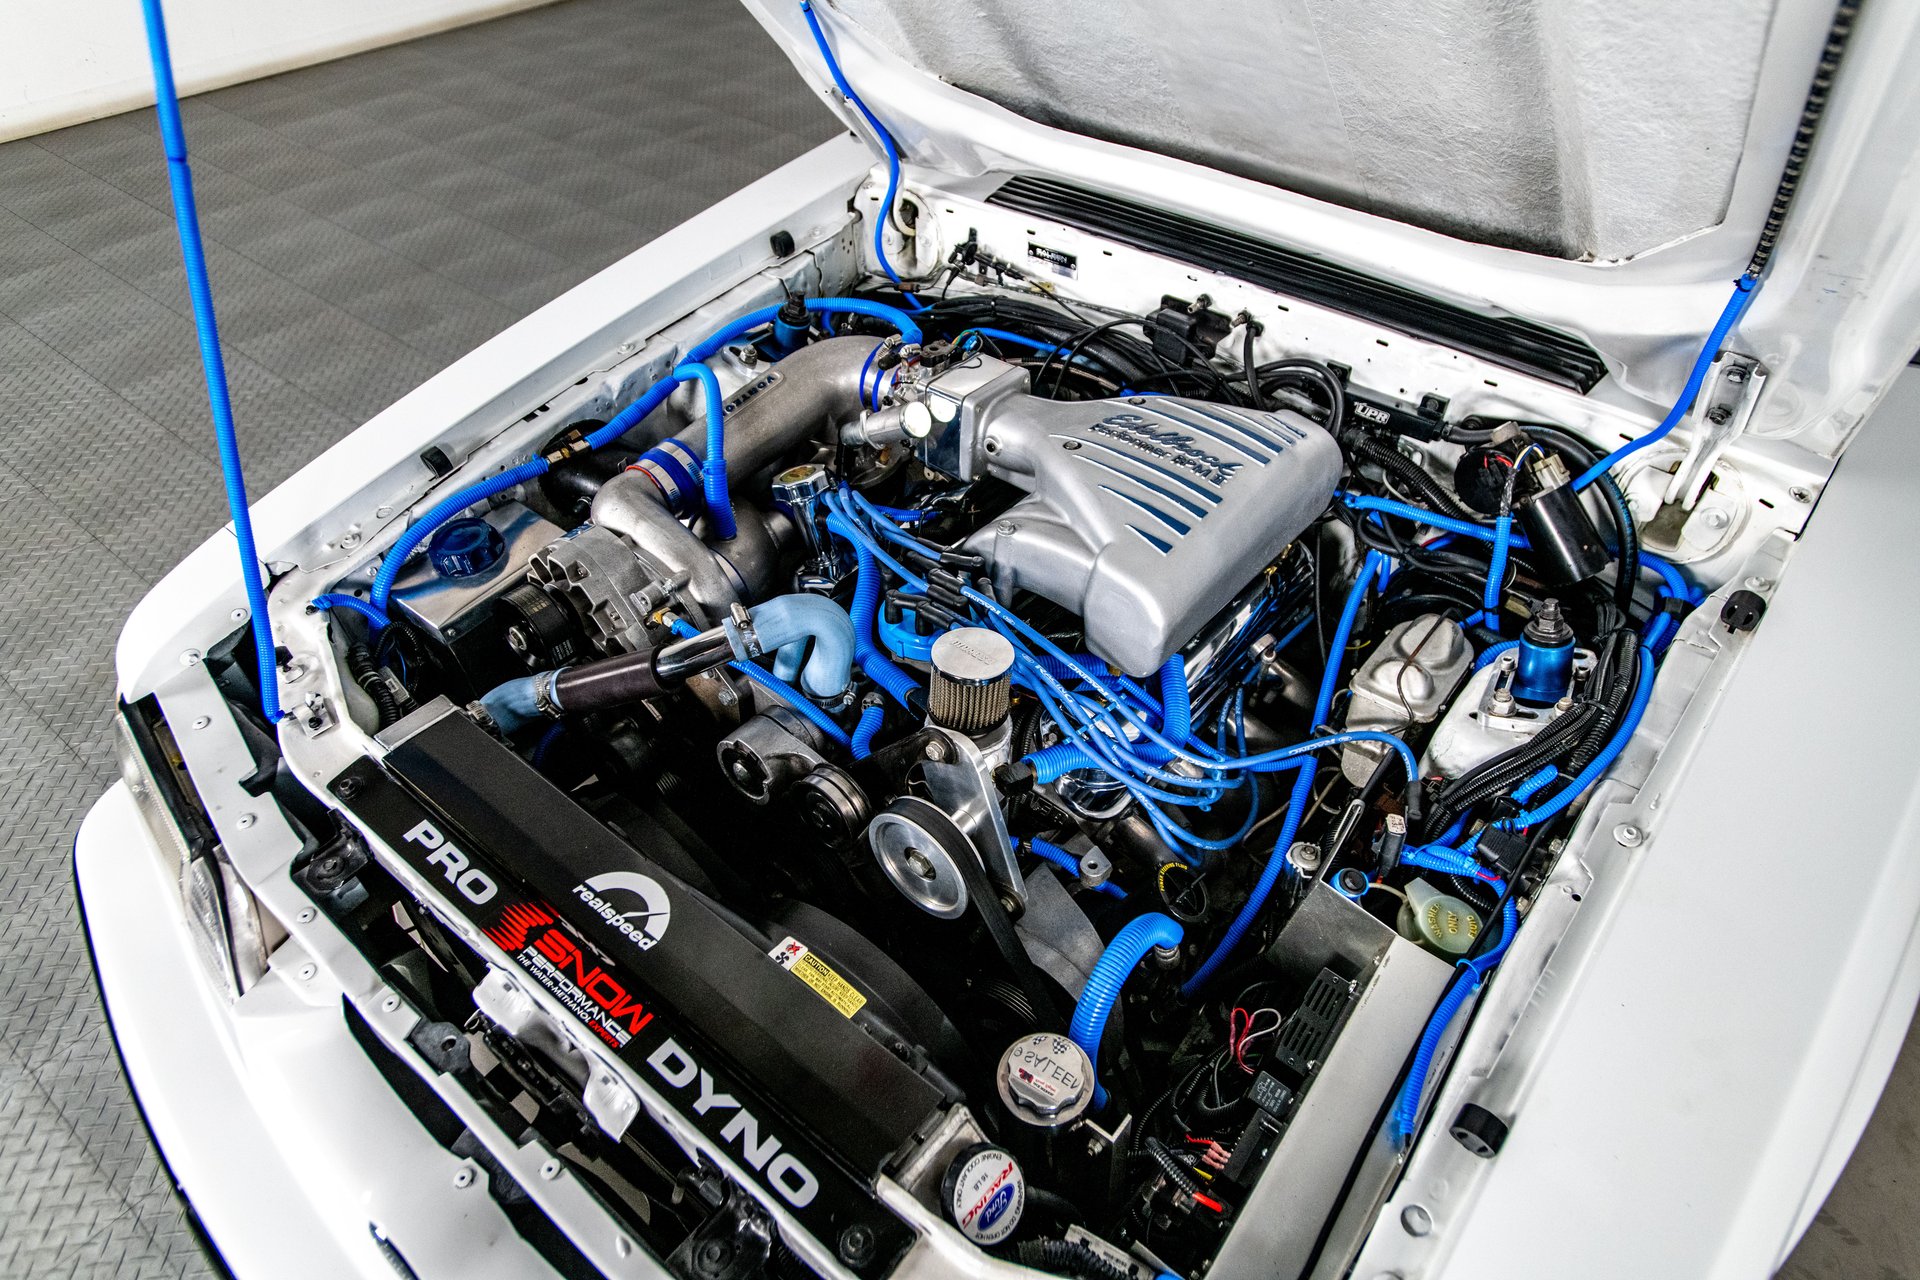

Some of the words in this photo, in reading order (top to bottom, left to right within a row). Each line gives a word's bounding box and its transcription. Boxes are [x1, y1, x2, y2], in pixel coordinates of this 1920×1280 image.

[1088, 422, 1171, 459] Performer
[1170, 454, 1211, 480] RPM
[1101, 414, 1244, 478] Edelbrock
[1035, 664, 1075, 703] RACING
[403, 820, 498, 905] PRO
[572, 884, 657, 951] realspeed
[1428, 902, 1442, 938] WASHER
[1448, 911, 1458, 934] ONLY
[1467, 915, 1478, 938] FLUID
[534, 929, 654, 1036] SNOW
[804, 955, 829, 976] CAUTION
[516, 954, 532, 968] THE
[588, 1019, 620, 1049] EXPERTS
[522, 945, 633, 1046] PERFORMANCE
[646, 1036, 819, 1208] DYNO
[961, 1158, 980, 1188] COOLANT
[982, 1153, 1002, 1161] ENGINE
[962, 1161, 1013, 1229] RACING
[973, 1180, 982, 1191] LB
[985, 1190, 1008, 1223] Ford
